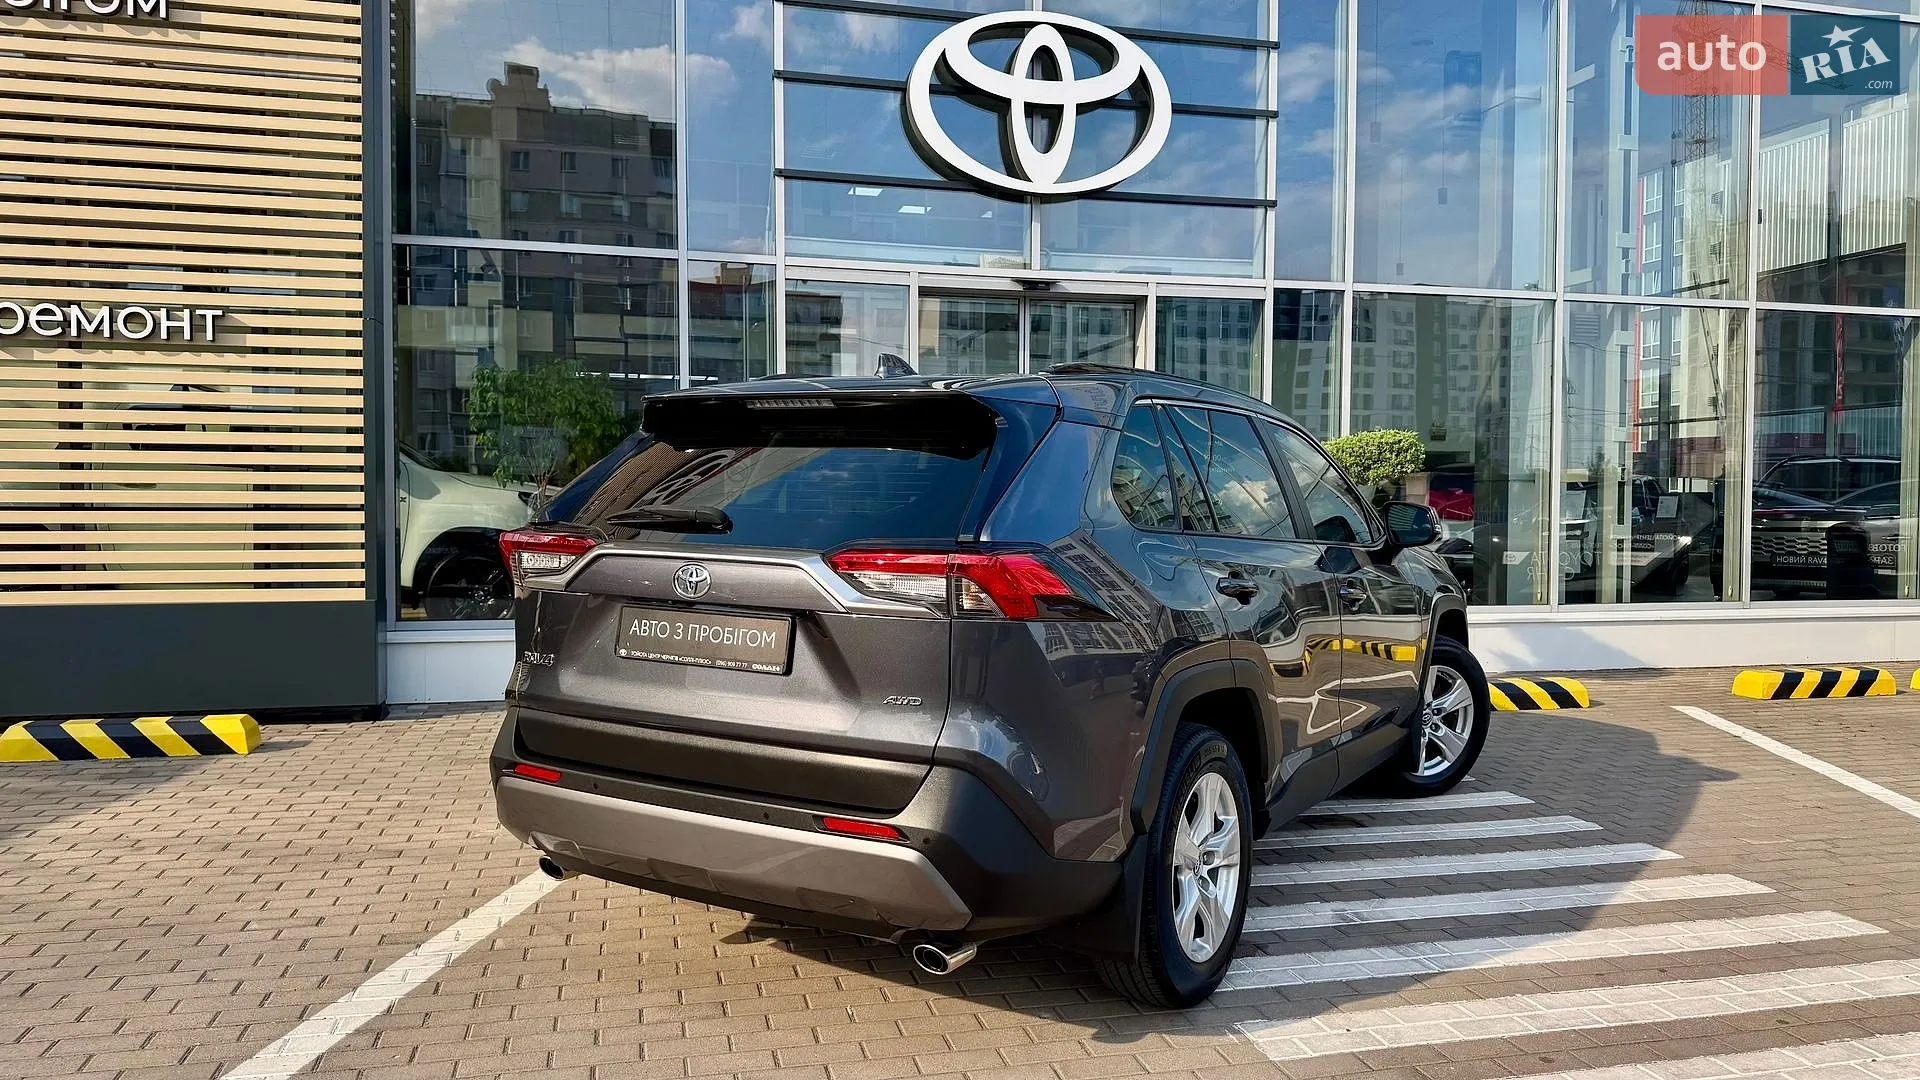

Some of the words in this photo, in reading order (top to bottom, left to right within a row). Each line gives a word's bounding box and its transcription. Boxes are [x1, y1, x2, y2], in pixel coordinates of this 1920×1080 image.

[1776, 554, 1806, 564] НОВИЙ
[629, 618, 670, 638] АВТО
[687, 624, 776, 649] ПРОБІГОМ
[882, 695, 922, 706] AWD
